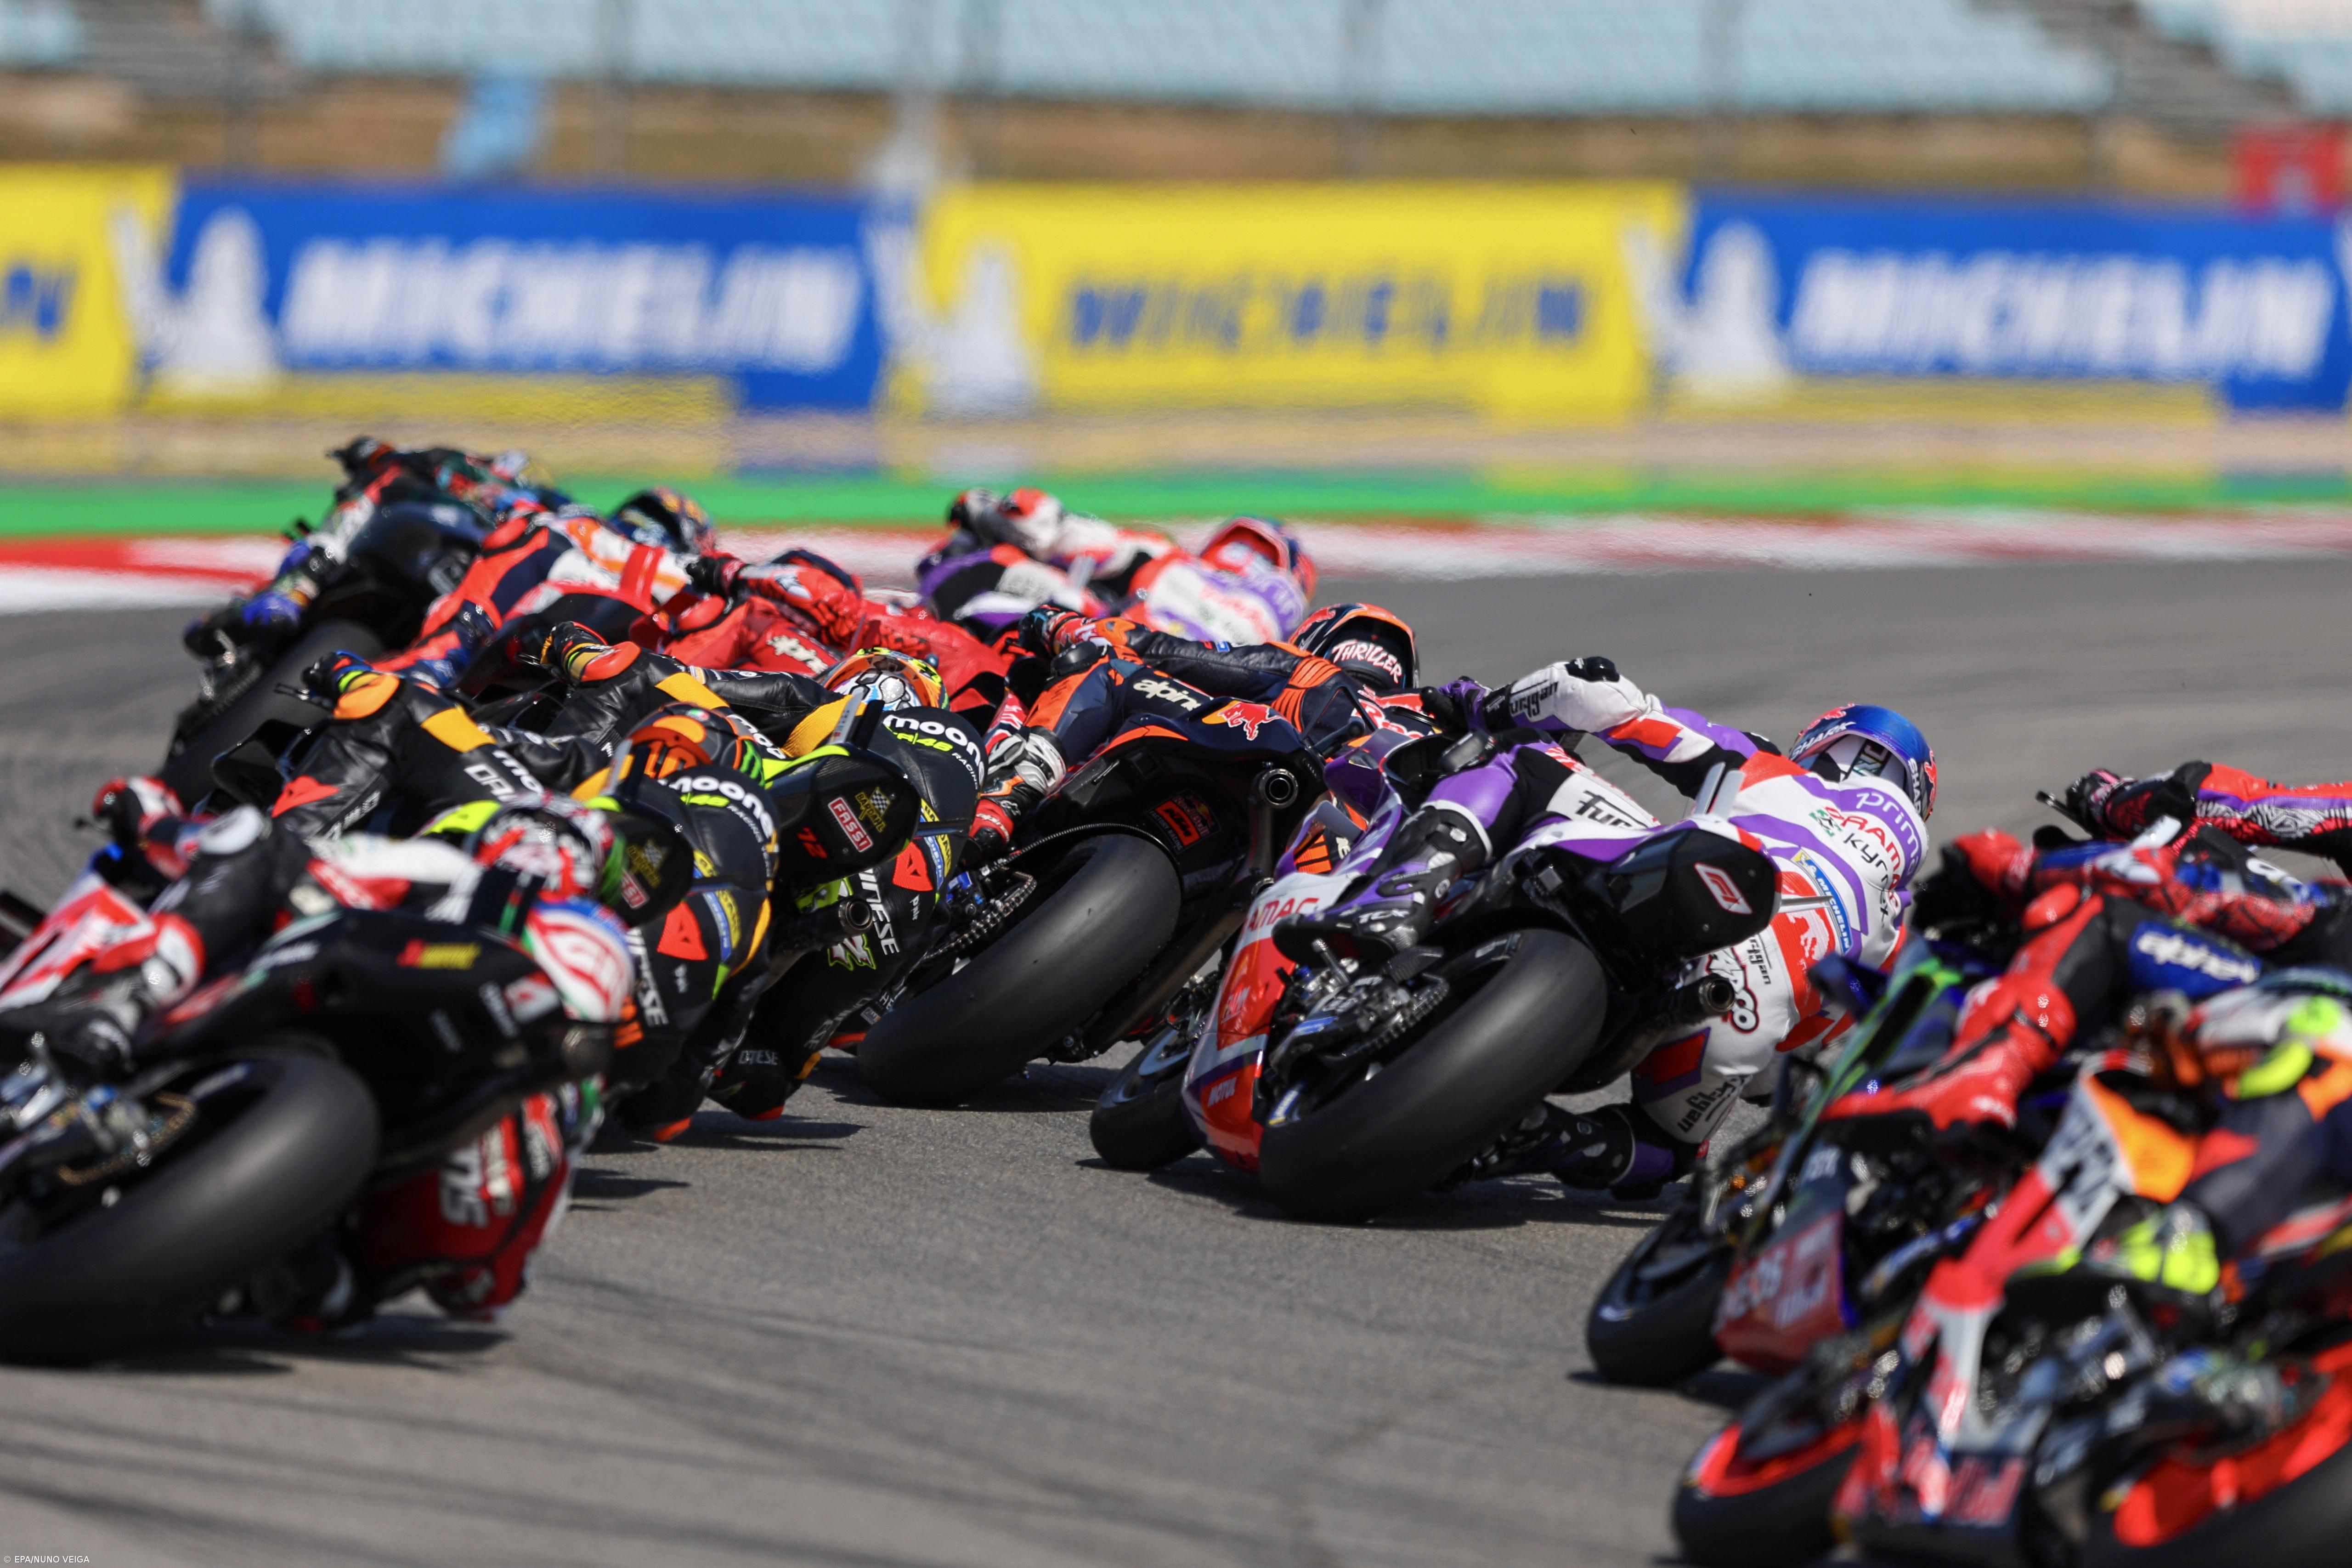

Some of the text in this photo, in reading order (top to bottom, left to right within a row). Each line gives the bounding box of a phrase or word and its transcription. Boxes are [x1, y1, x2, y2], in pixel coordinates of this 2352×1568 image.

[1332, 640, 1402, 684] THRILLER
[1791, 721, 1856, 761] SHARK
[834, 804, 867, 846] FASSI
[1164, 808, 1193, 837] KTM
